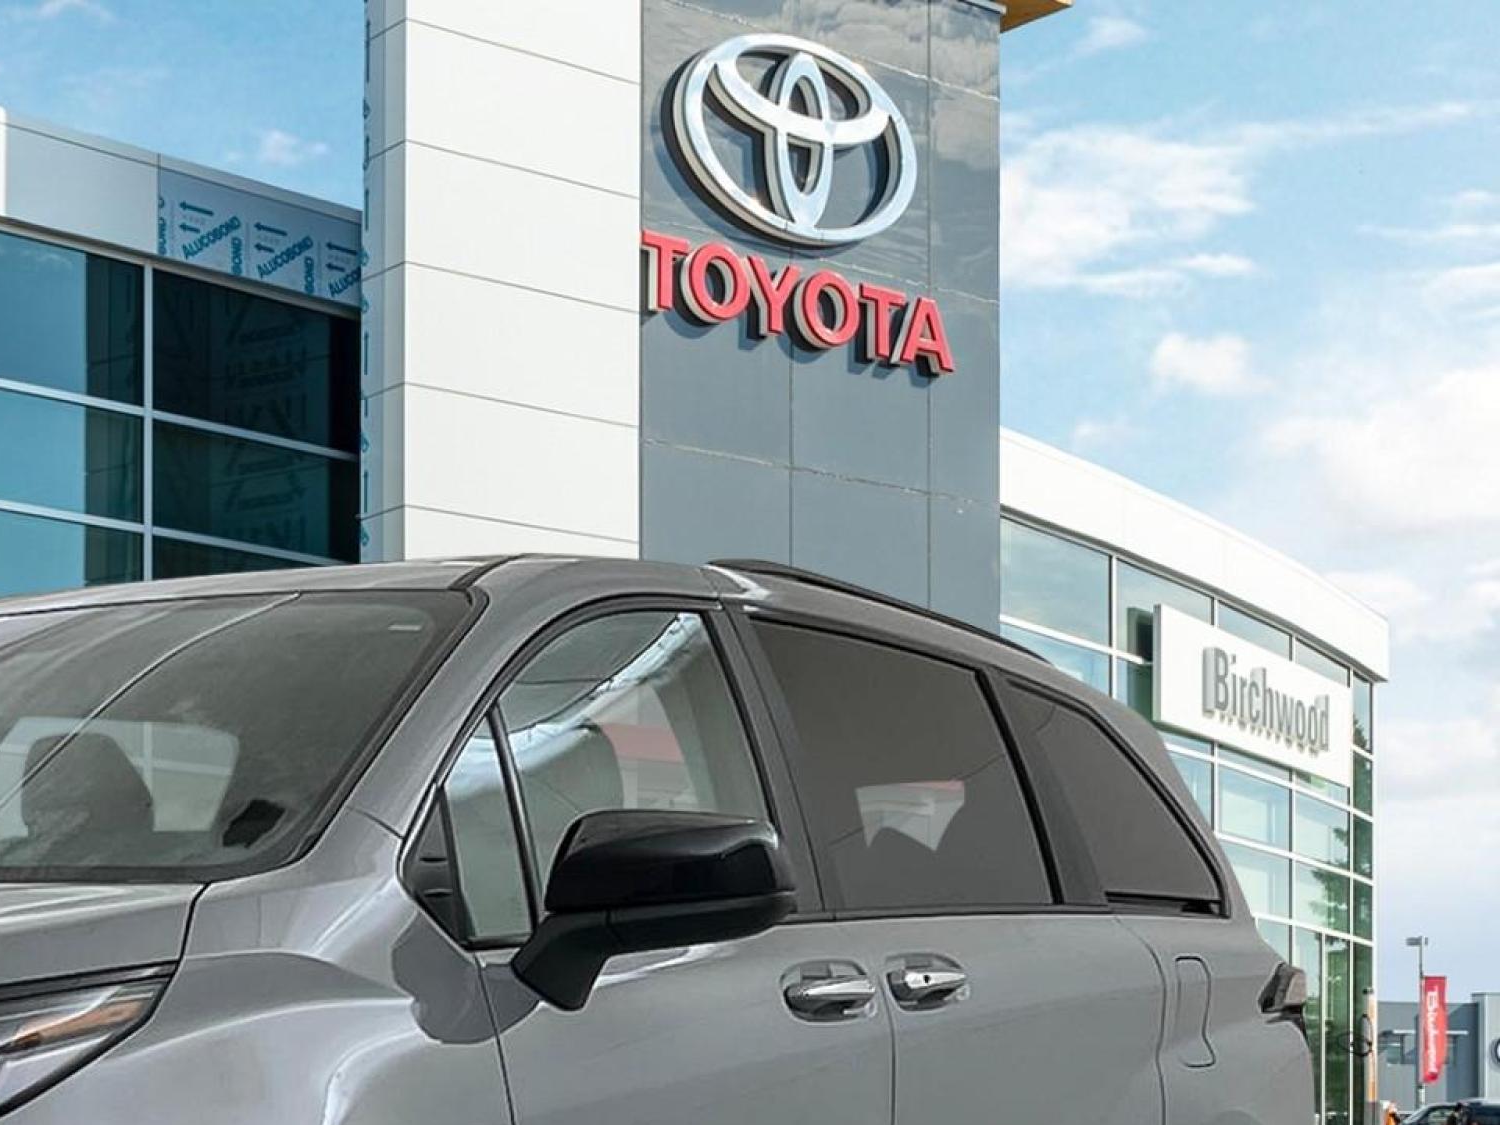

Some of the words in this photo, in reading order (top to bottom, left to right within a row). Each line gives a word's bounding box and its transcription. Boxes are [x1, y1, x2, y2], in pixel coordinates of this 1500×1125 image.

[181, 215, 242, 260] ALUCOBOND
[256, 235, 314, 279] ALUCOBOND
[641, 230, 956, 373] TOYOTA
[1202, 647, 1330, 756] Birchwood
